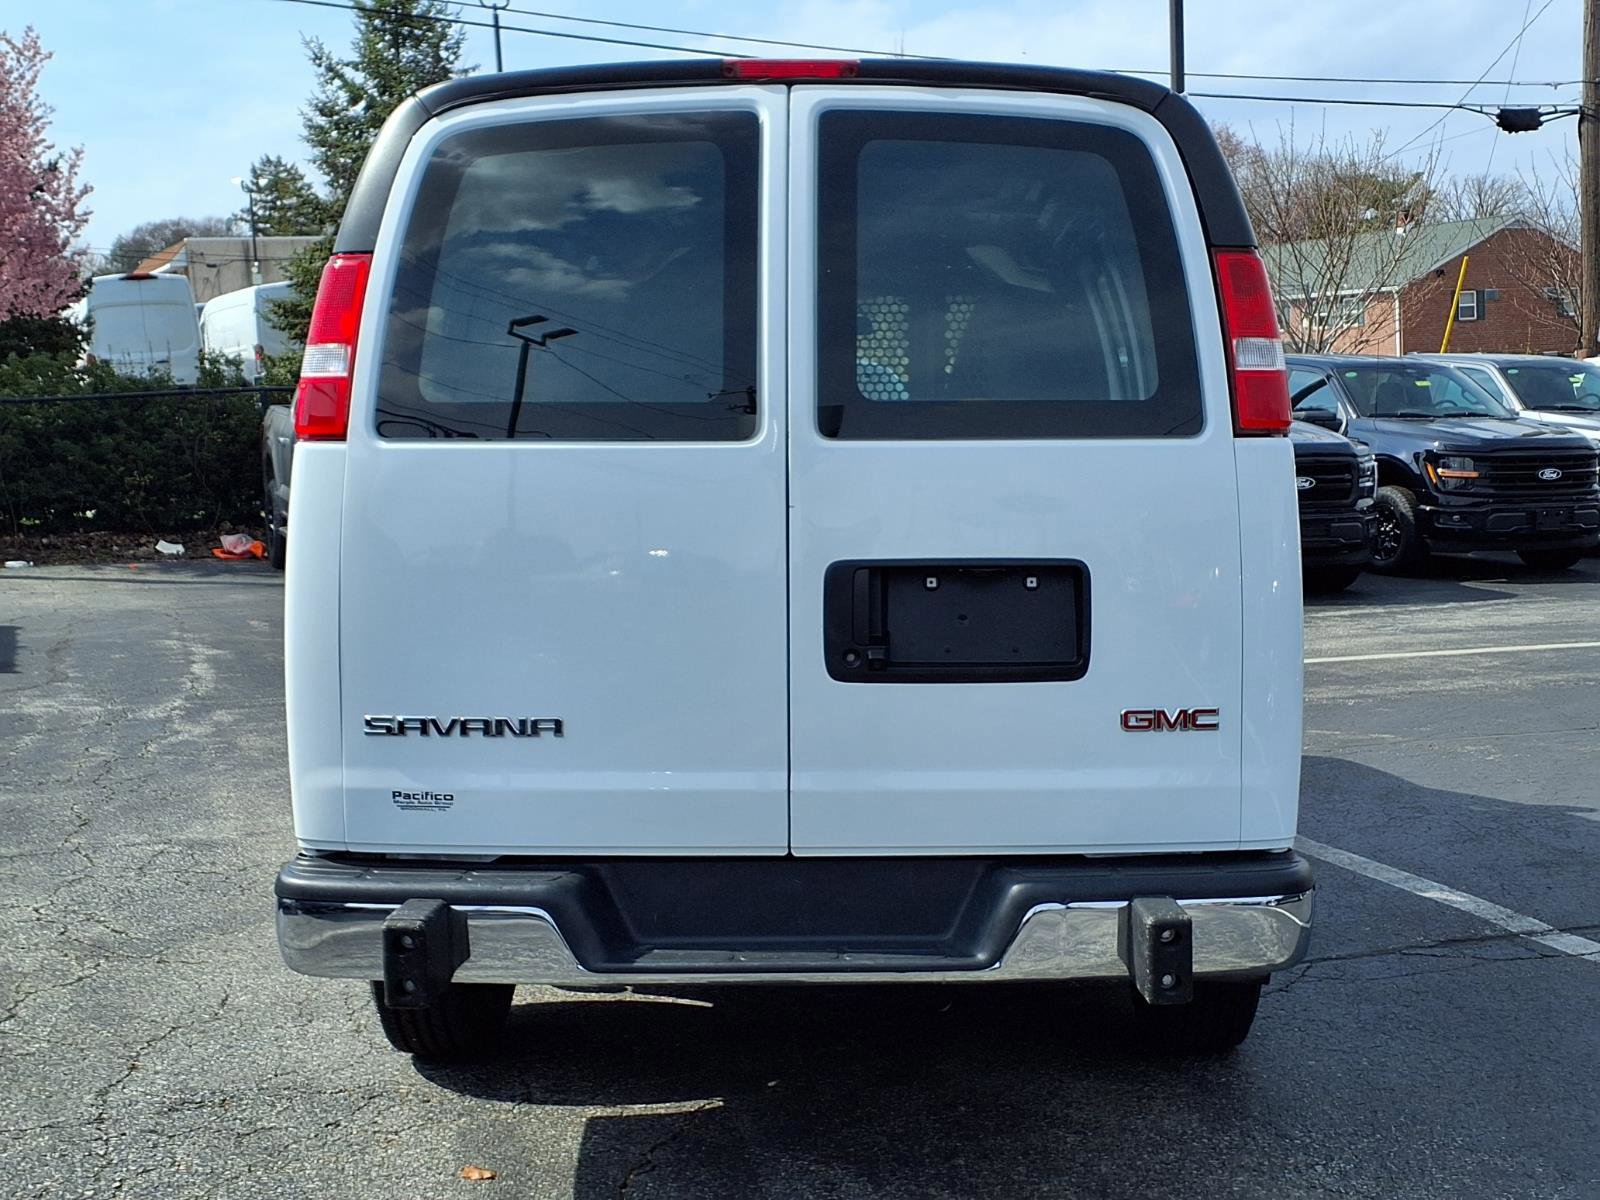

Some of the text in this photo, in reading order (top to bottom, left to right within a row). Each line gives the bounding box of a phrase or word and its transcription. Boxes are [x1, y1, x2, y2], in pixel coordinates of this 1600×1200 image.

[364, 715, 564, 737] SAVANA
[1120, 707, 1219, 732] GMC
[392, 791, 454, 801] Pacifico
